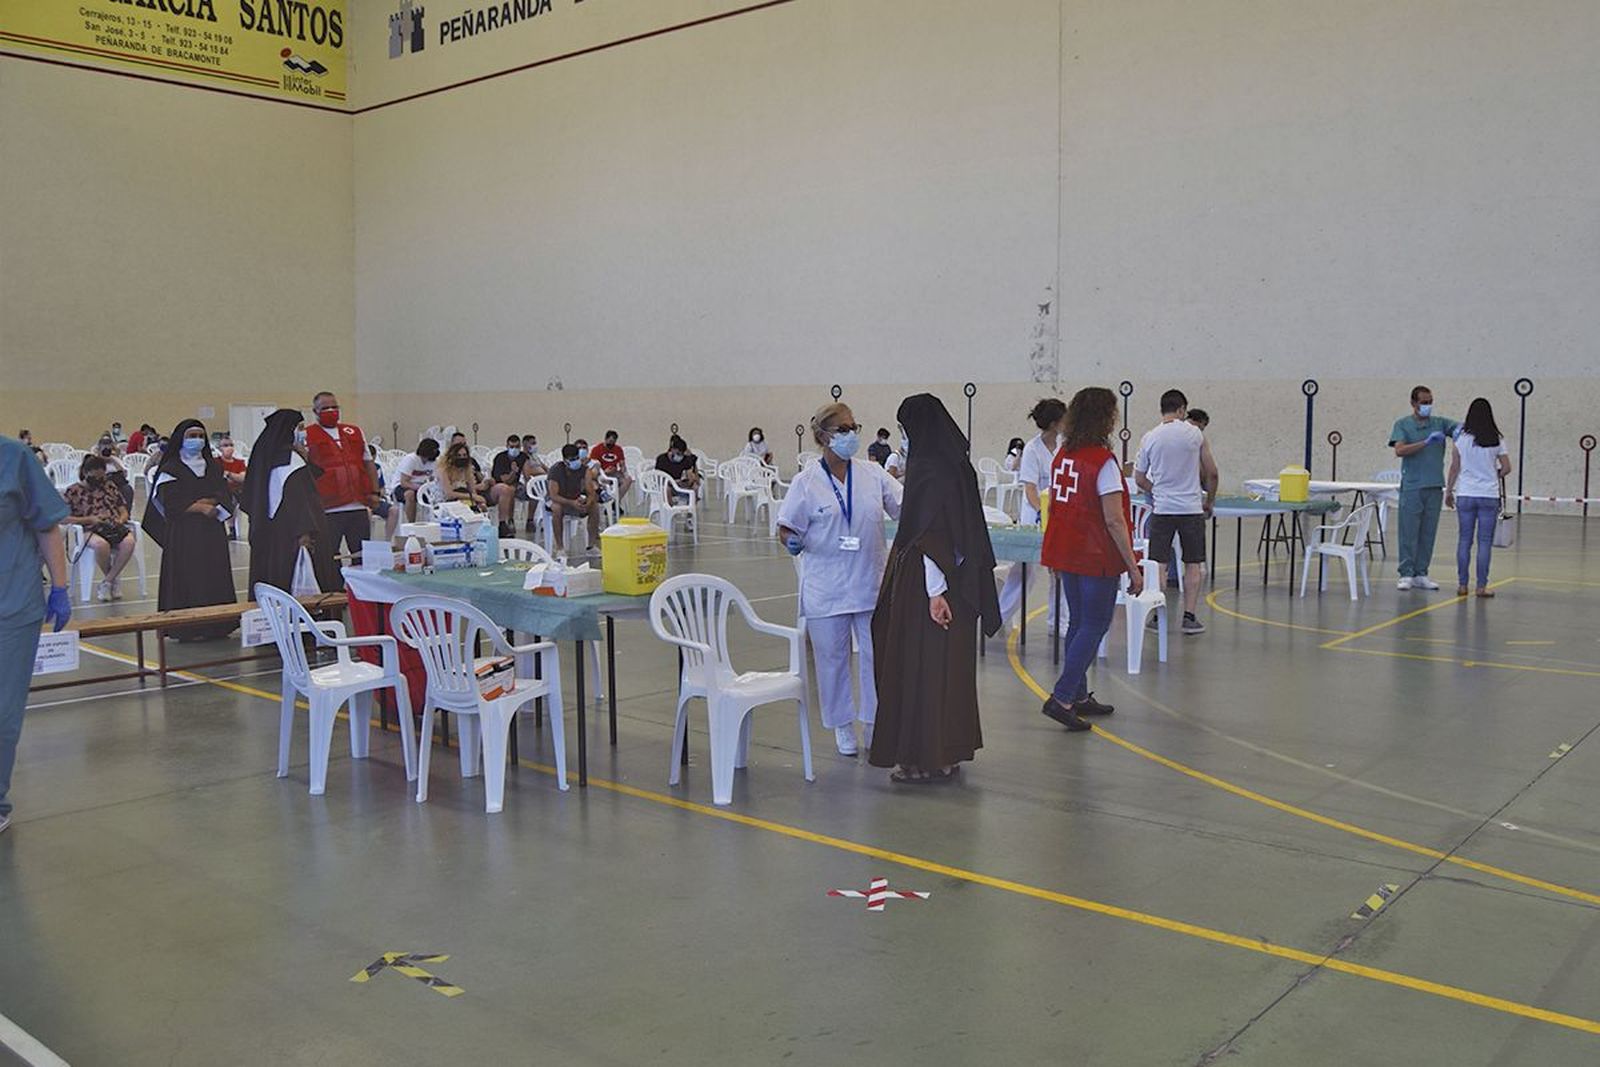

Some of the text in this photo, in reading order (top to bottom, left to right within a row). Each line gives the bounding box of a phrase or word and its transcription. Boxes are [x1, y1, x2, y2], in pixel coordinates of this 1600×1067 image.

[239, 0, 343, 48] SANTOS
[440, 0, 552, 45] PEÑARANDA
[95, 34, 221, 66] PEÑARANDA DE BRACAMONTE
